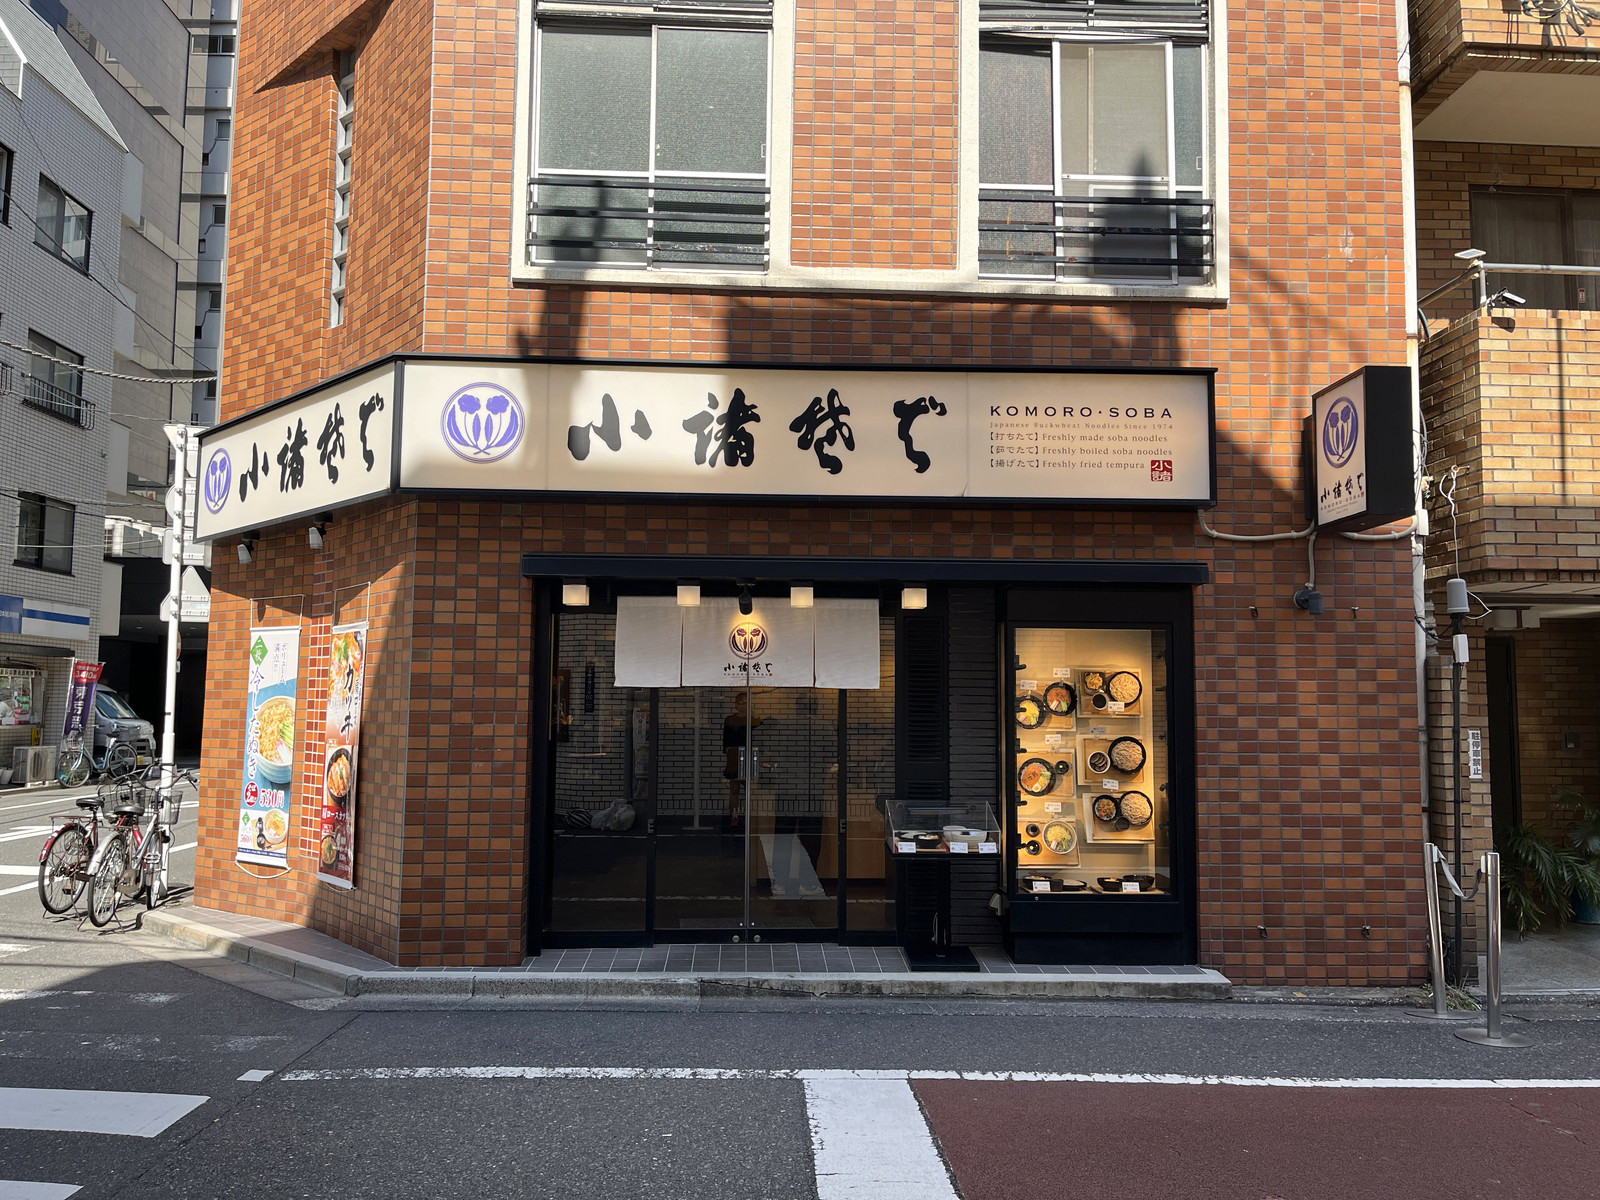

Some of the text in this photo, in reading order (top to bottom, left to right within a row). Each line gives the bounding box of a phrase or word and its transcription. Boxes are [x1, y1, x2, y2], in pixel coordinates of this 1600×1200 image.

[1042, 434, 1076, 442] Freshly
[1042, 447, 1076, 455] Freshly
[1042, 460, 1076, 469] Freshly
[248, 666, 264, 777] 冷したぬき
[1471, 732, 1481, 776] 駐停車禁止
